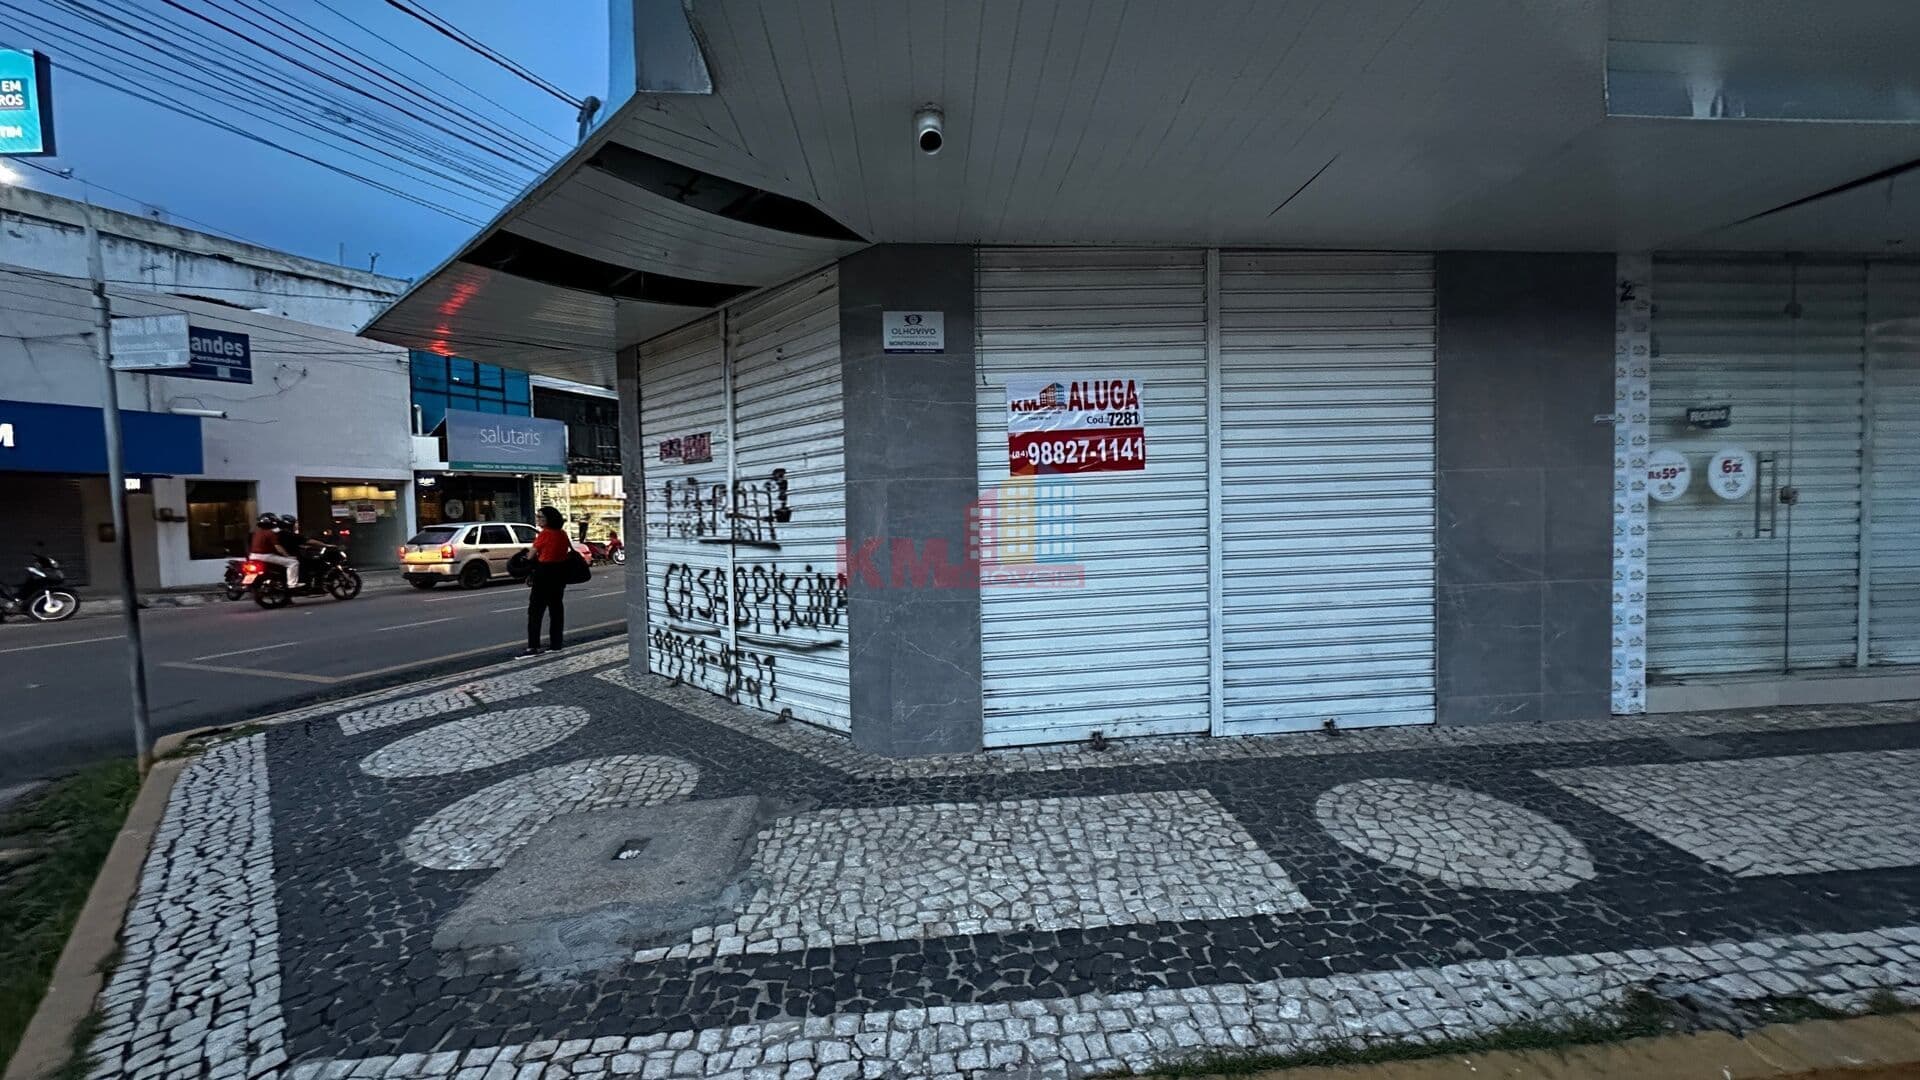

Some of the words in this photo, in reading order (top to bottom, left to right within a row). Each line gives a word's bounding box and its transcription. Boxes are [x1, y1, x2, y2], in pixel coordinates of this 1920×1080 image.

[1068, 379, 1139, 412] ALUGA
[1107, 411, 1139, 426] 7281
[480, 425, 541, 446] salutaris
[1027, 437, 1144, 466] 98827-1141
